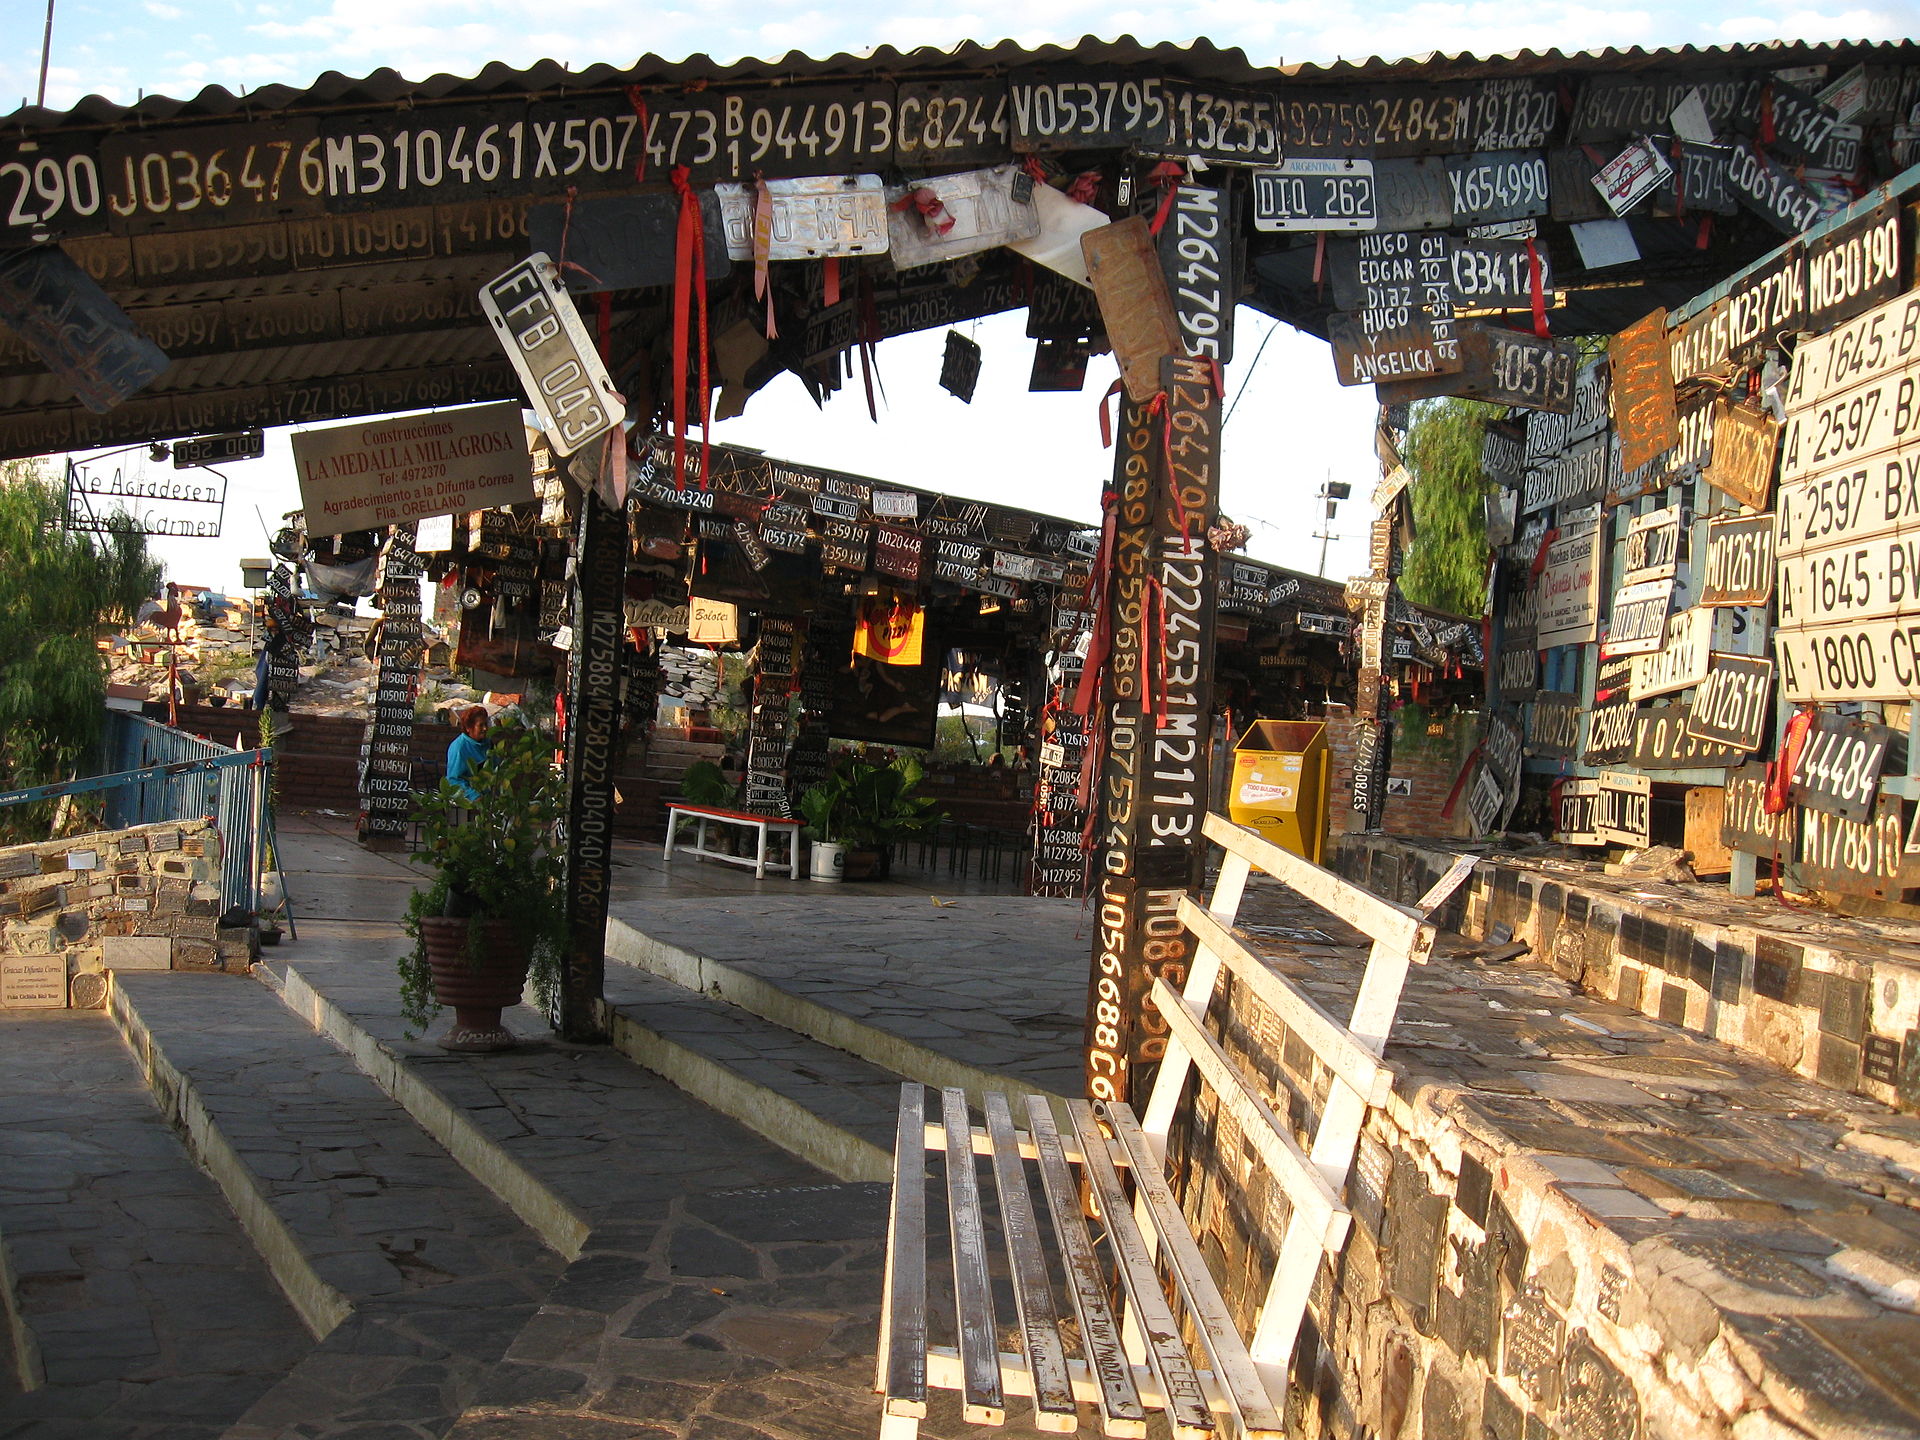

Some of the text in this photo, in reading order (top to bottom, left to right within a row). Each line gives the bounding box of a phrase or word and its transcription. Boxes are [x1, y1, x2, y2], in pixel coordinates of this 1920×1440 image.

[1012, 79, 1164, 137] V053795
[326, 121, 523, 196] M310461
[534, 109, 717, 178] X507473
[1289, 161, 1338, 173] ARGENTINA
[0, 155, 99, 225] 290
[108, 137, 324, 216] J036476
[1258, 178, 1309, 217] DIQ
[1324, 178, 1372, 216] 262
[1448, 158, 1549, 215] X654990
[1728, 146, 1820, 233] C061647
[1176, 185, 1221, 359] M264795
[1360, 232, 1409, 258] HUGO
[1360, 257, 1415, 284] EDGAR
[1810, 217, 1899, 314] M030190
[1363, 306, 1410, 334] HUGO
[1729, 258, 1804, 349] M237204
[494, 268, 604, 441] FFB 043
[1368, 335, 1379, 353] Y
[306, 431, 513, 481] LA MEDALLA MILAGROSA
[362, 420, 454, 447] Construcciones
[1812, 388, 1882, 463] 2597
[323, 472, 515, 514] Agradecimiento a la Difunta Correa
[402, 464, 446, 482] 4972370
[144, 509, 218, 537] Carmen
[375, 494, 466, 521] Flia. ORELLANO
[1804, 469, 1868, 541] 2597
[938, 539, 981, 561] X707095
[1706, 530, 1771, 592] M012611
[1810, 550, 1871, 615] 1645
[1811, 631, 1876, 692] 1800
[1692, 666, 1767, 737] M012611
[1105, 702, 1136, 876] J075340
[1353, 773, 1369, 811] S3780
[1625, 794, 1648, 834] 443
[1803, 806, 1901, 879] M178810
[1094, 879, 1128, 1050] J056688
